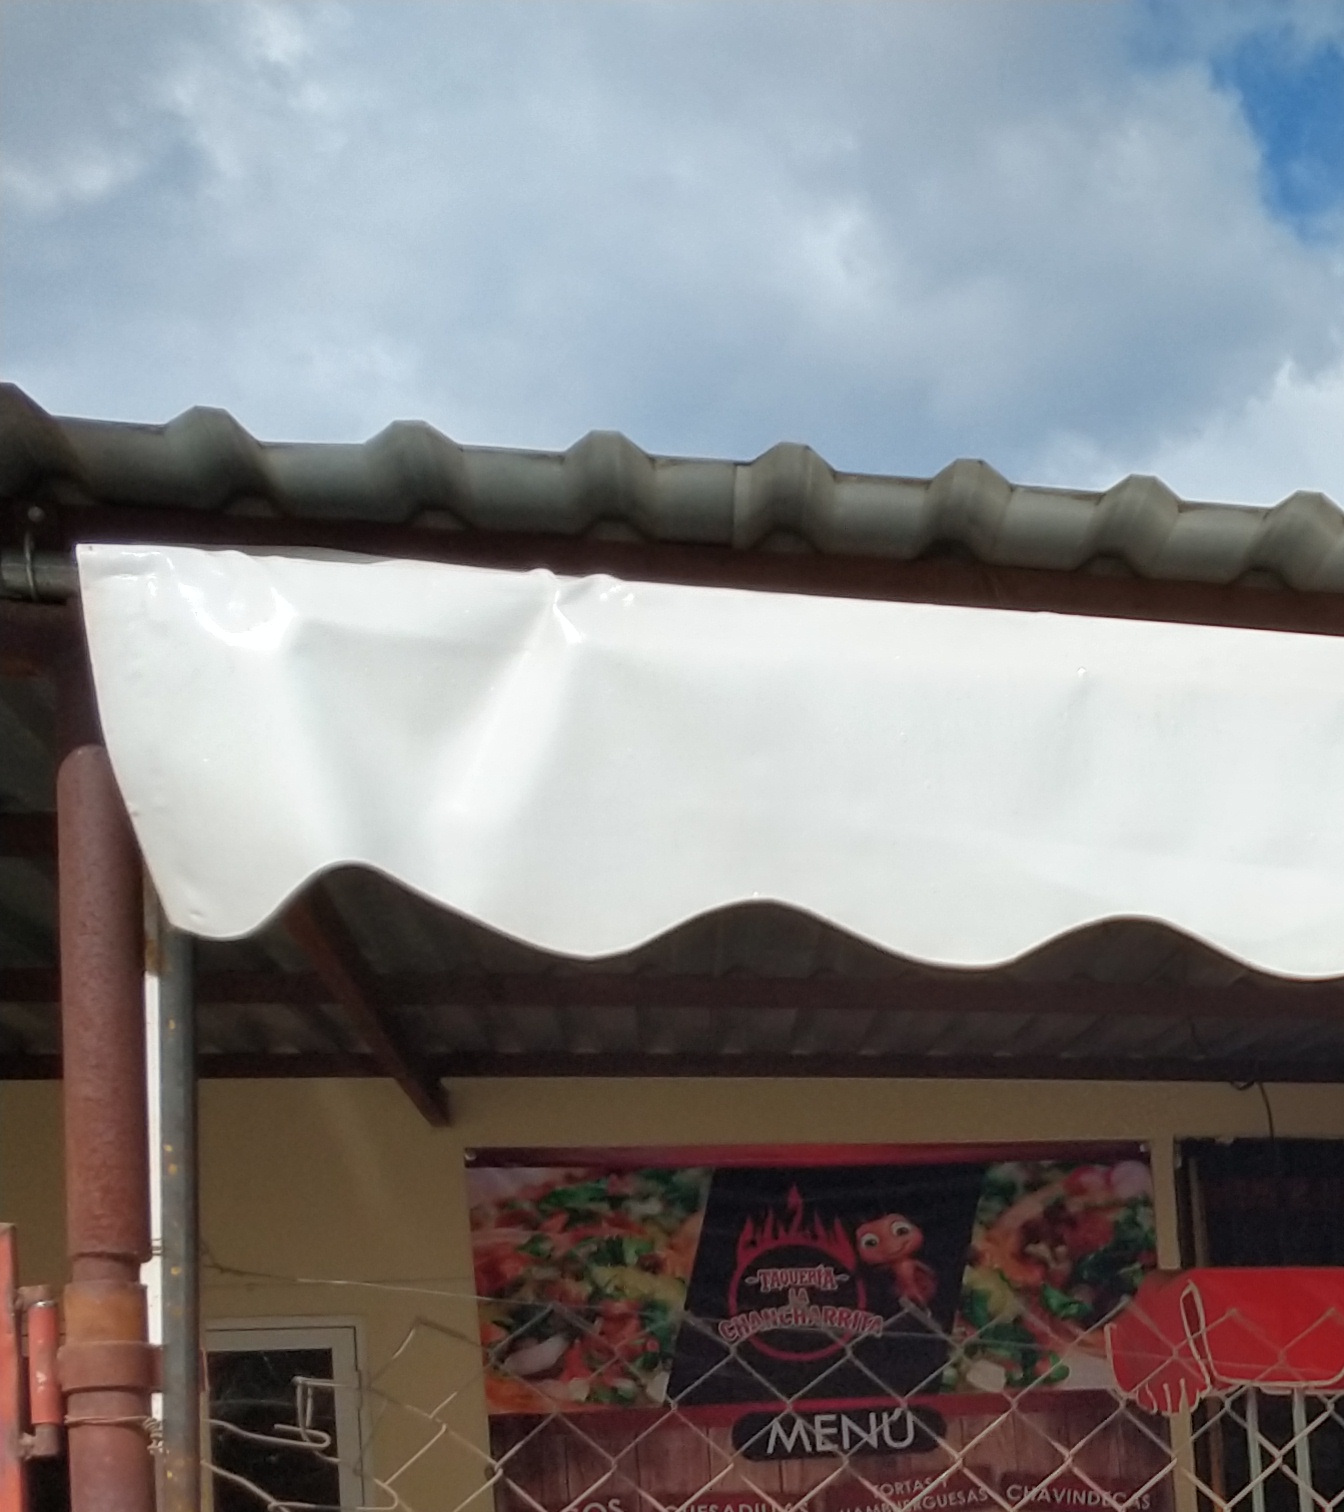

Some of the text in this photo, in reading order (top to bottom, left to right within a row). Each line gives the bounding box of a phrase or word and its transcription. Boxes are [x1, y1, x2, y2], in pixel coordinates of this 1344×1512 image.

[718, 1306, 884, 1341] CHANCHARRITA
[766, 1407, 916, 1456] MENÚ
[1006, 1485, 1151, 1511] CHAVINDECAS
